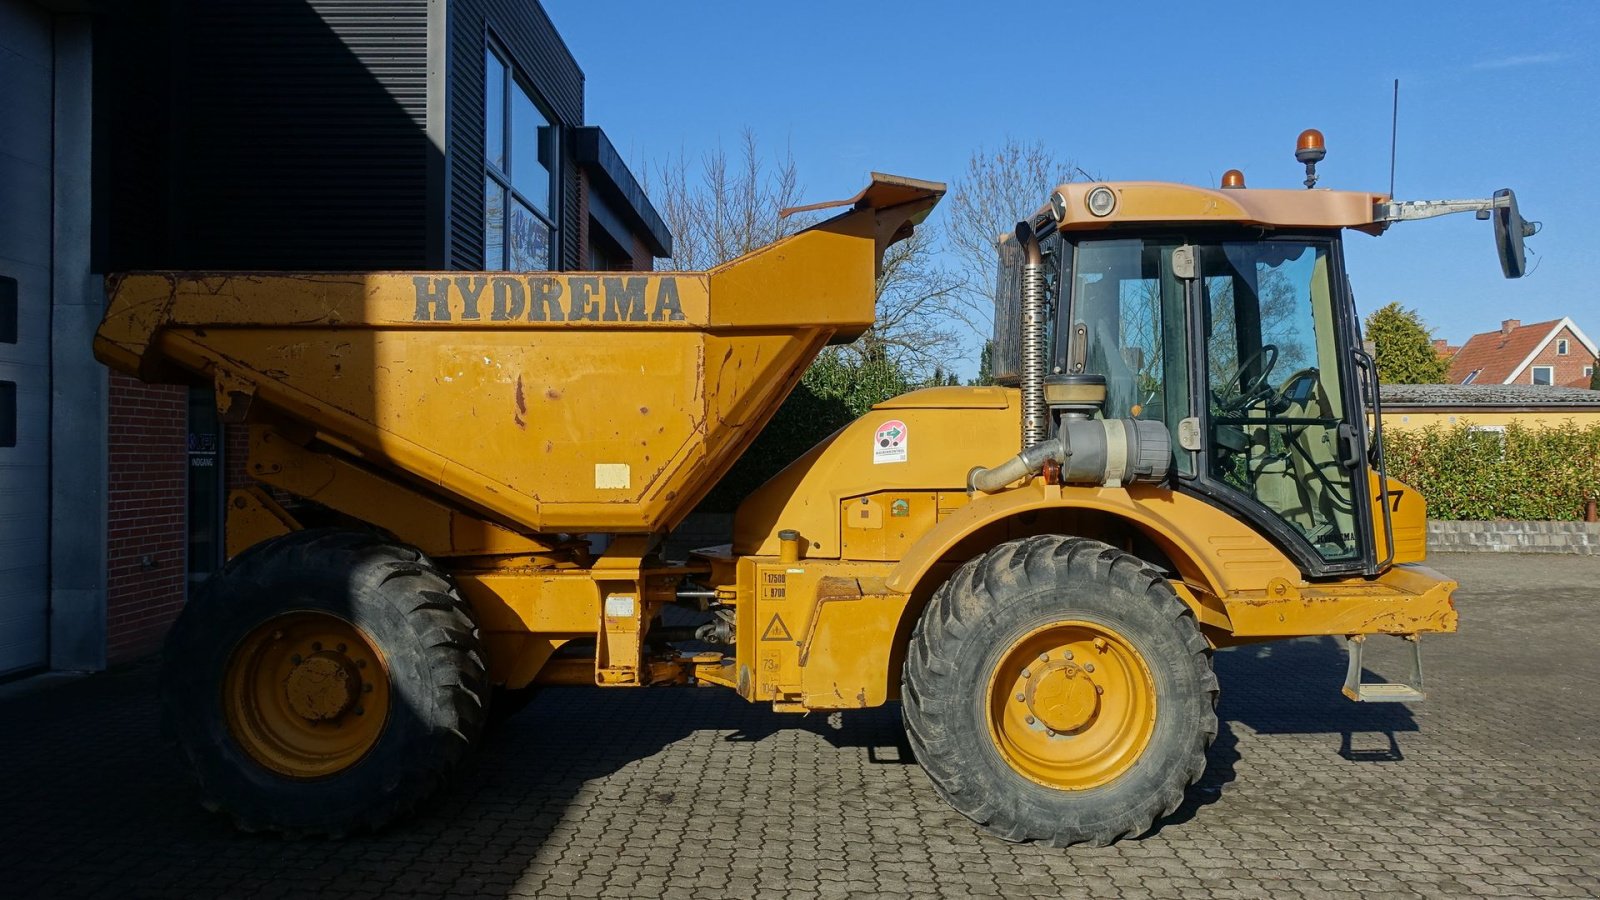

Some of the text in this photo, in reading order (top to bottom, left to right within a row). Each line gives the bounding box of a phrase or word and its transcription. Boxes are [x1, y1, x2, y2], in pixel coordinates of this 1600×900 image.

[412, 276, 686, 322] HYDREMA
[768, 574, 785, 583] 17500
[771, 588, 785, 597] 9700
[763, 658, 774, 671] 73
